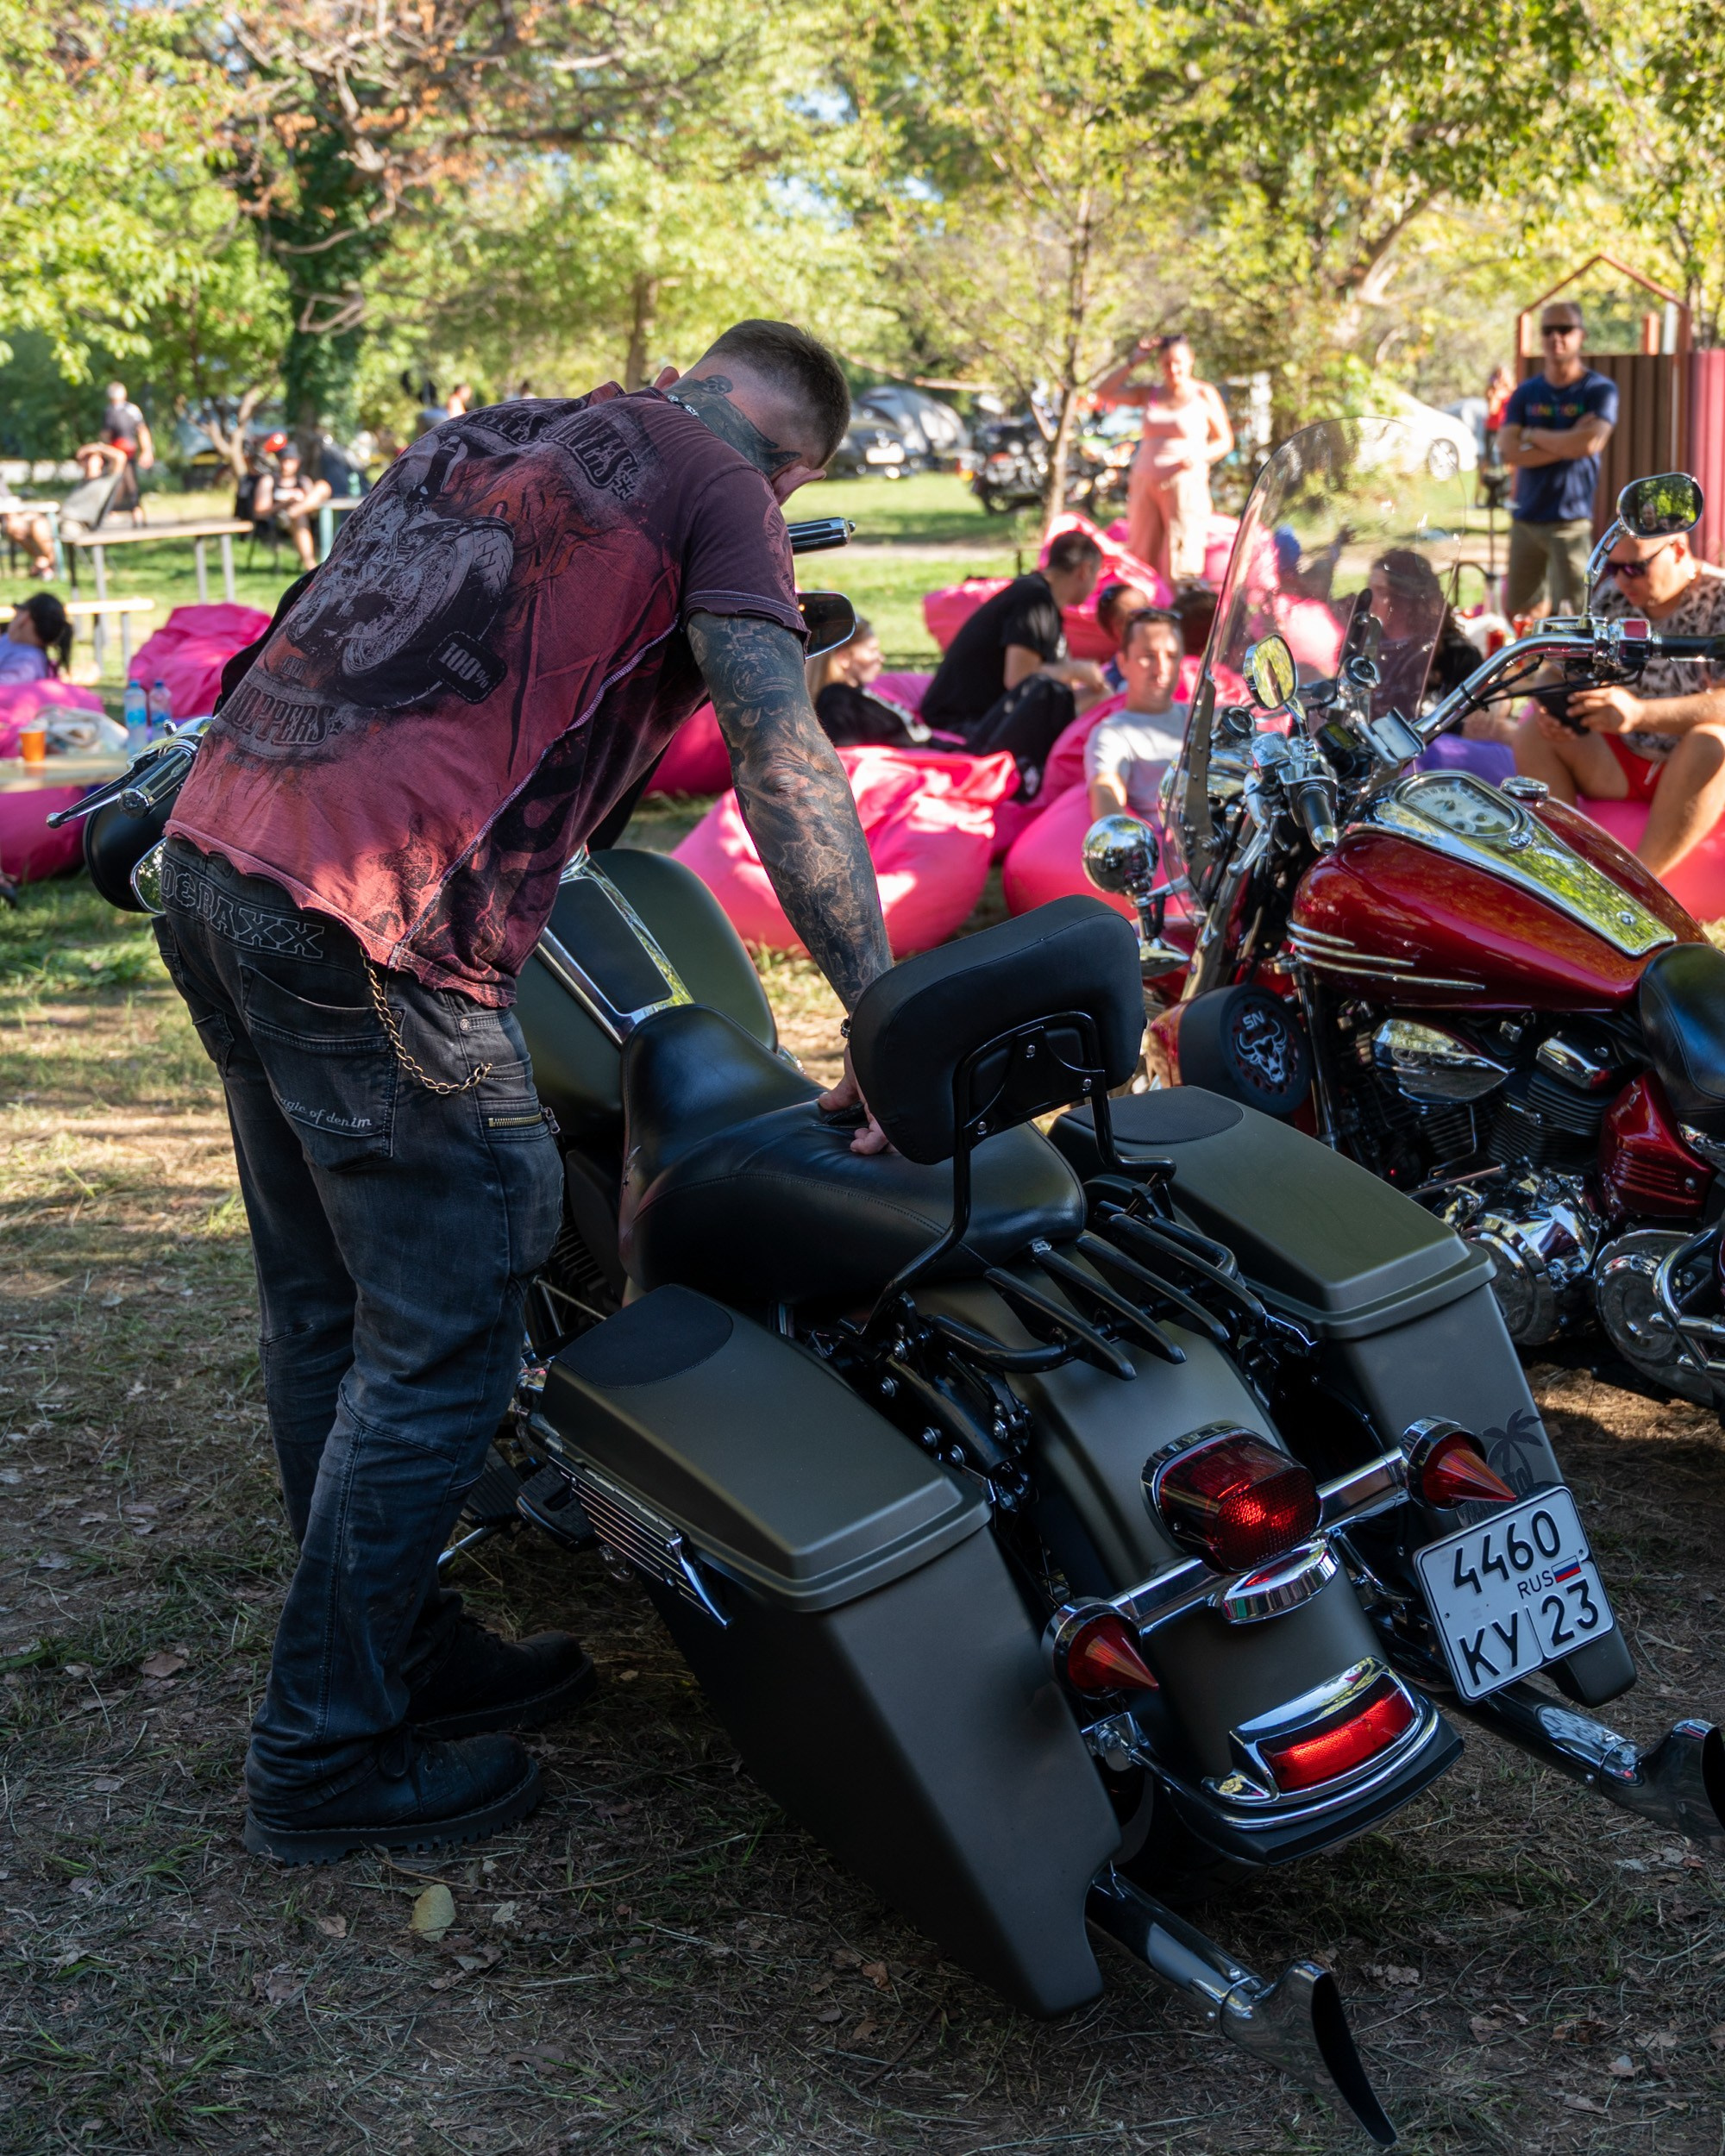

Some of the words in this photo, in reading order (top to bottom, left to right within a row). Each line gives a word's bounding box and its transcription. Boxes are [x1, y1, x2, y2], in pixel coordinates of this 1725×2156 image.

[438, 642, 491, 688] 100%
[1242, 1010, 1265, 1031] SN
[310, 1109, 326, 1125] of
[327, 1112, 372, 1128] denim
[1453, 1509, 1560, 1594] 4460
[1517, 1570, 1553, 1599] RUS
[1458, 1612, 1518, 1686] KY
[1541, 1578, 1599, 1646] 23
